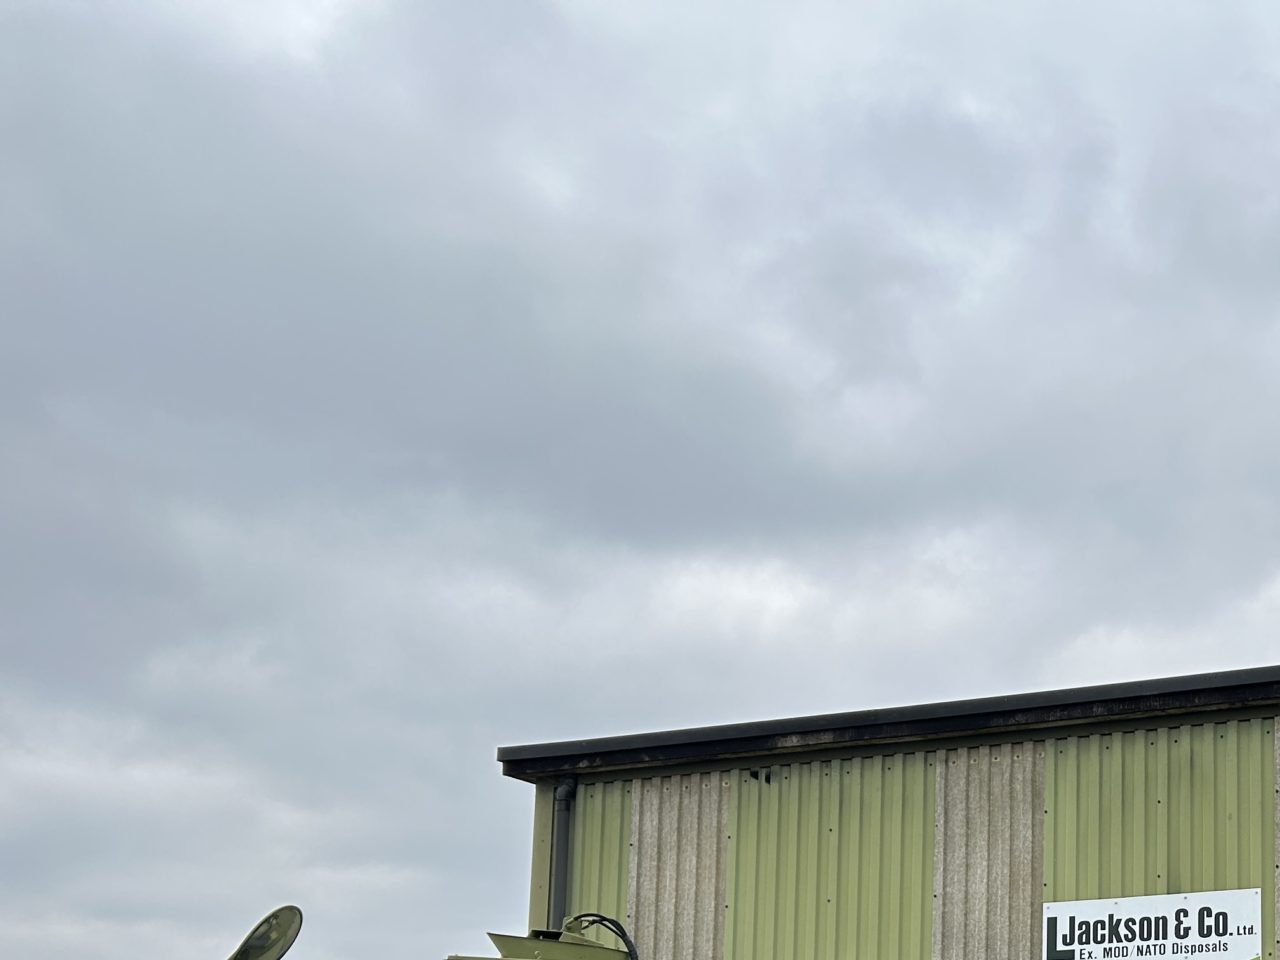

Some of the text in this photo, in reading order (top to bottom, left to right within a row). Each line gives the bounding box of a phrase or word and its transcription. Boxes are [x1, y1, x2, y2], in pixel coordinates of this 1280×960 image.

[1174, 908, 1191, 939] &
[1197, 906, 1234, 938] Co.
[1237, 924, 1257, 936] Ltd.
[1079, 940, 1229, 960] Ex. MOD/NATO Disposals
